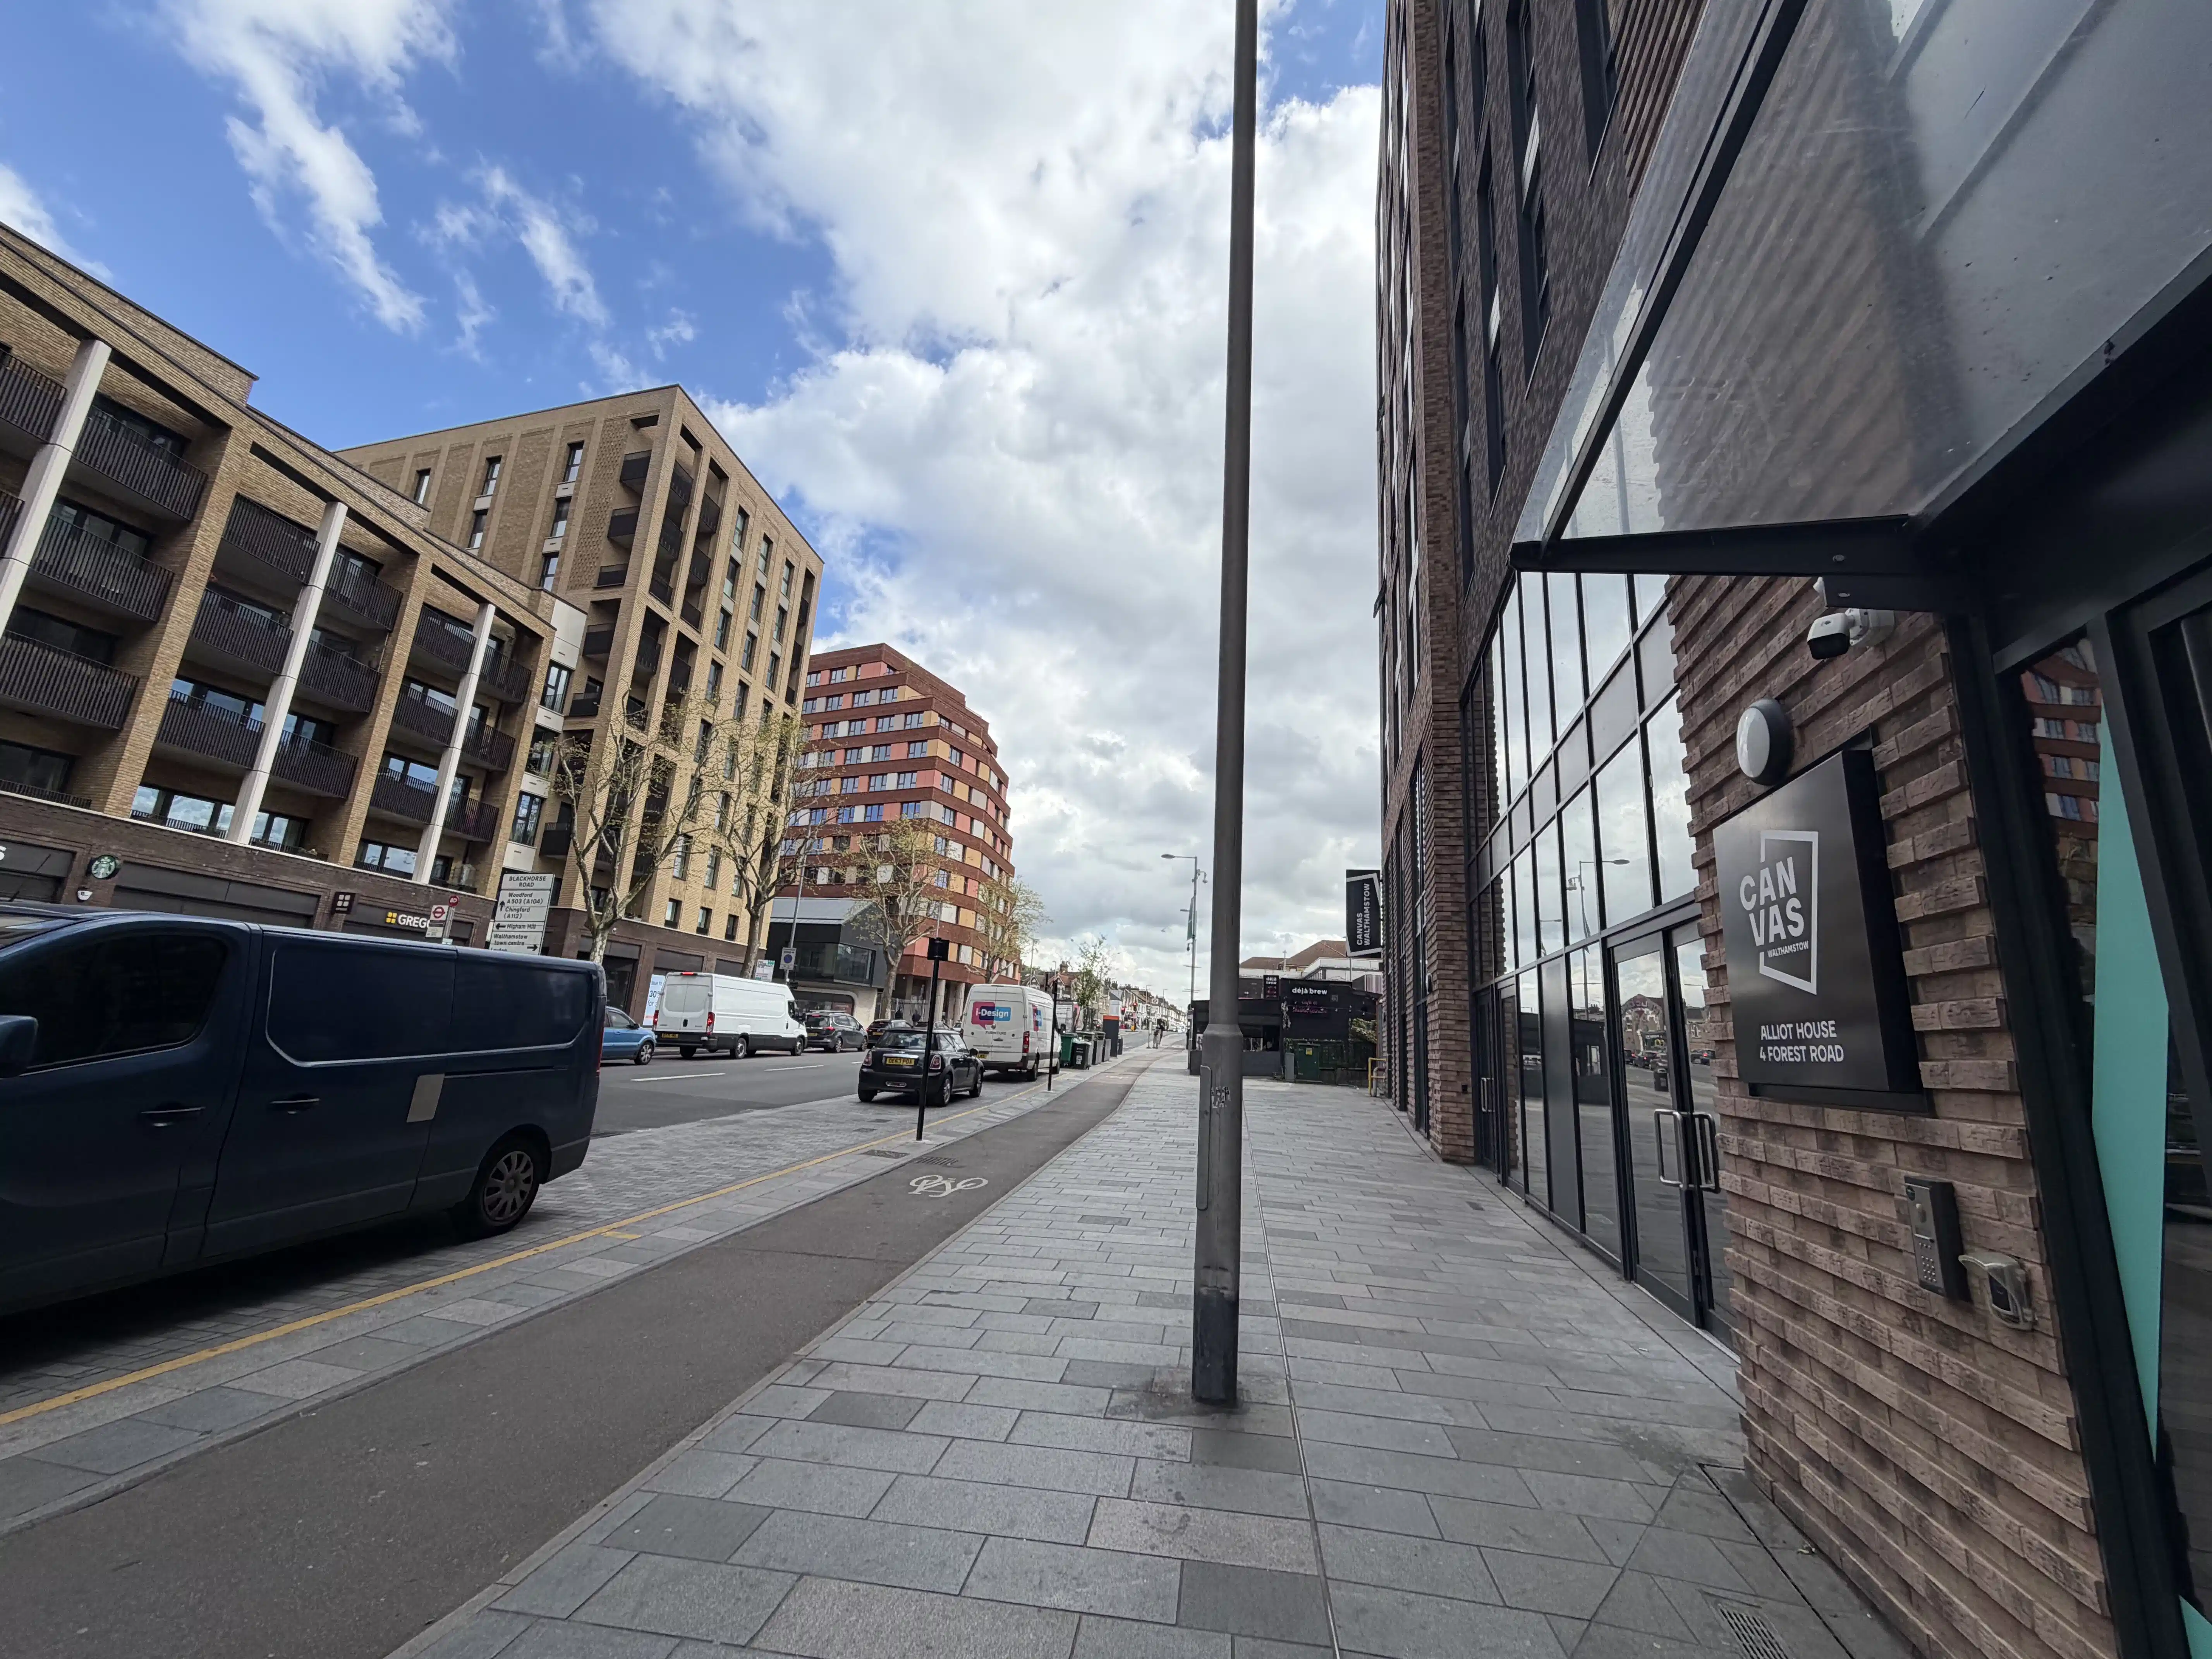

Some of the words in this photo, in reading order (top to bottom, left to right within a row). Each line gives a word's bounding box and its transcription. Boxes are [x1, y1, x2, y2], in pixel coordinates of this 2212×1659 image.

[1740, 857, 1796, 910] CAN
[1749, 897, 1804, 946] VAS
[1767, 940, 1809, 958] WALTHAMSTOW
[975, 1008, 1009, 1018] i-Design
[1761, 1024, 1793, 1040] ALLIOT
[1796, 1020, 1837, 1039] HOUSE
[1760, 1046, 1766, 1061] 4
[1767, 1046, 1807, 1062] FOREST
[1809, 1045, 1844, 1062] ROAD
